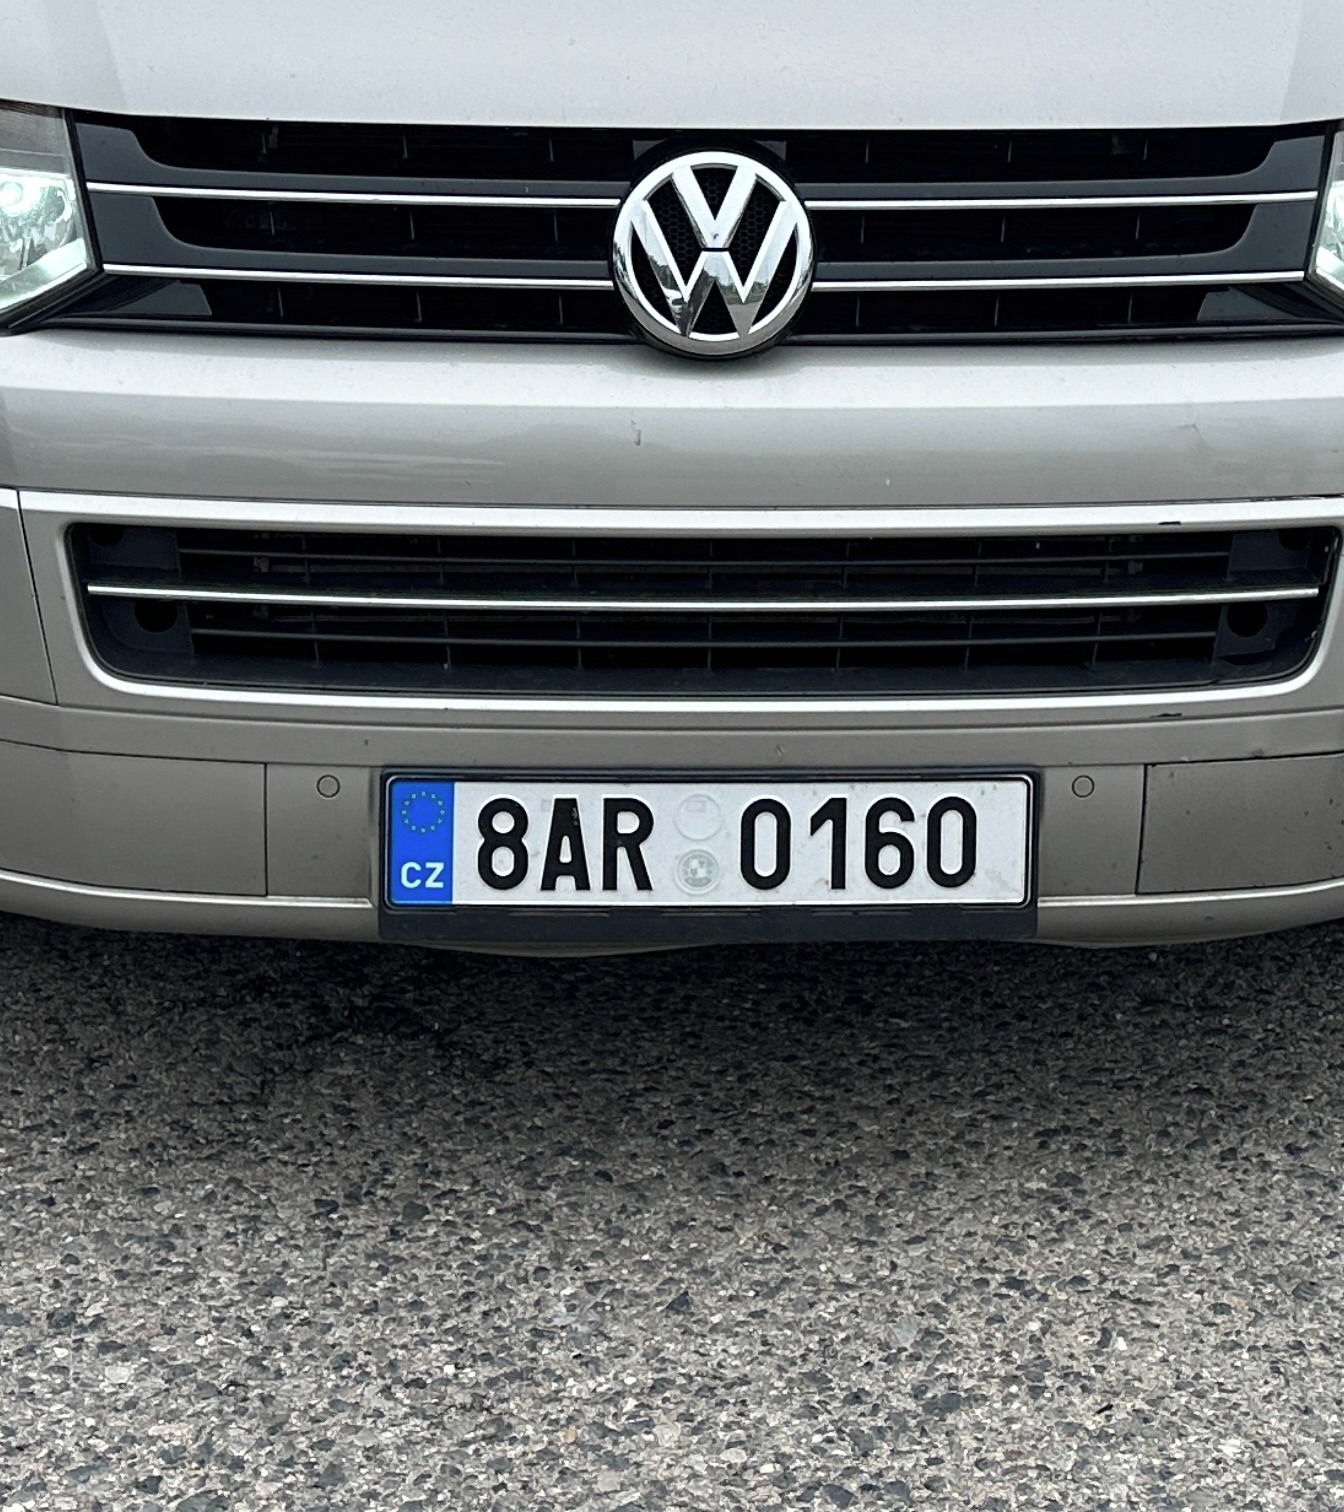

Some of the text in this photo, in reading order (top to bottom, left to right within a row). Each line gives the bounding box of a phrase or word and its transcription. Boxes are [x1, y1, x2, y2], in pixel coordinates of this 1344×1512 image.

[400, 795, 979, 892] CZ 8AR 0160
